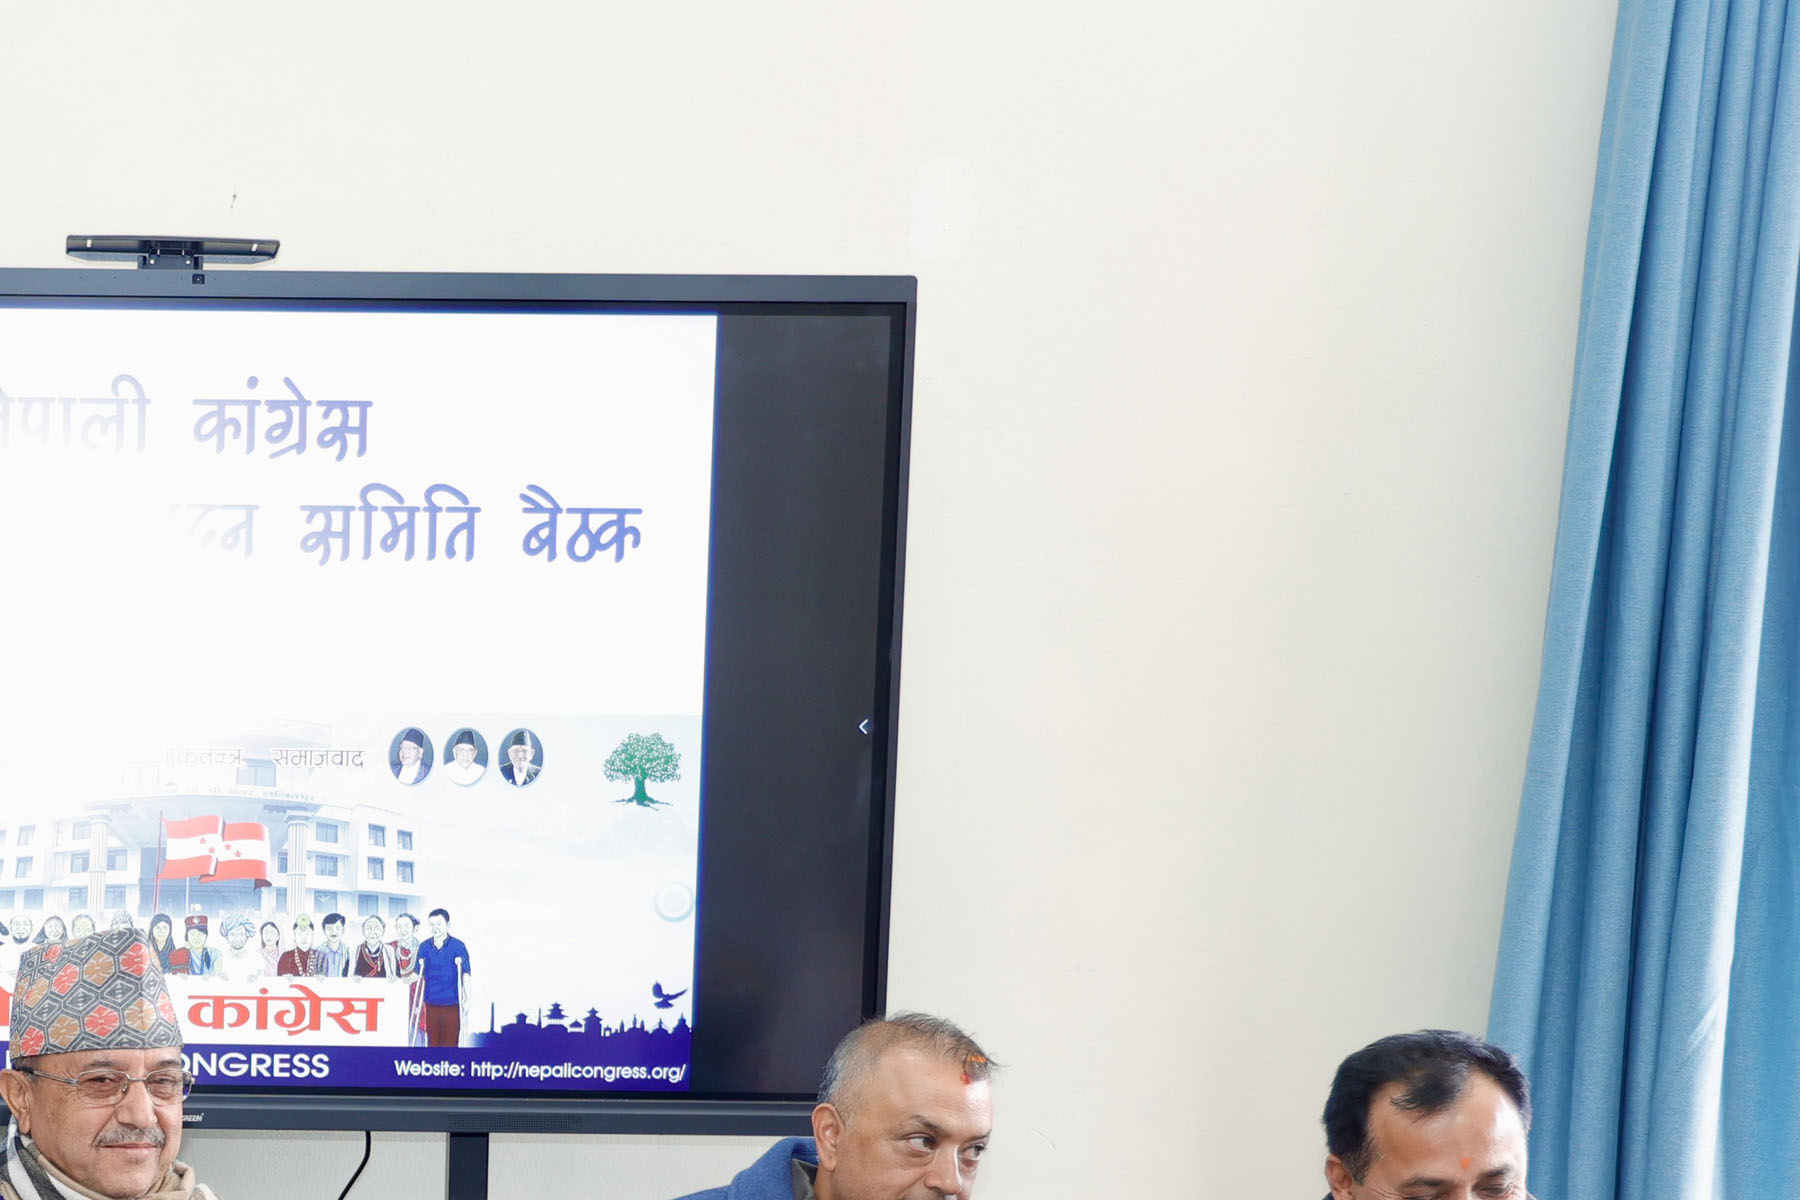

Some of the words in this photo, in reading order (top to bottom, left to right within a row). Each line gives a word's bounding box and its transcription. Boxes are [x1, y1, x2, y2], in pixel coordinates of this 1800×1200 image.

[191, 375, 375, 463] कांग्रेस
[299, 482, 484, 567] समिति
[518, 483, 644, 565] बैठक
[273, 748, 365, 768] समाजवाद
[186, 983, 384, 1036] कांग्रेस
[180, 1052, 330, 1079] NGRESS
[394, 1059, 465, 1077] Website:
[470, 1061, 686, 1084] http://nepalicongress.org/
